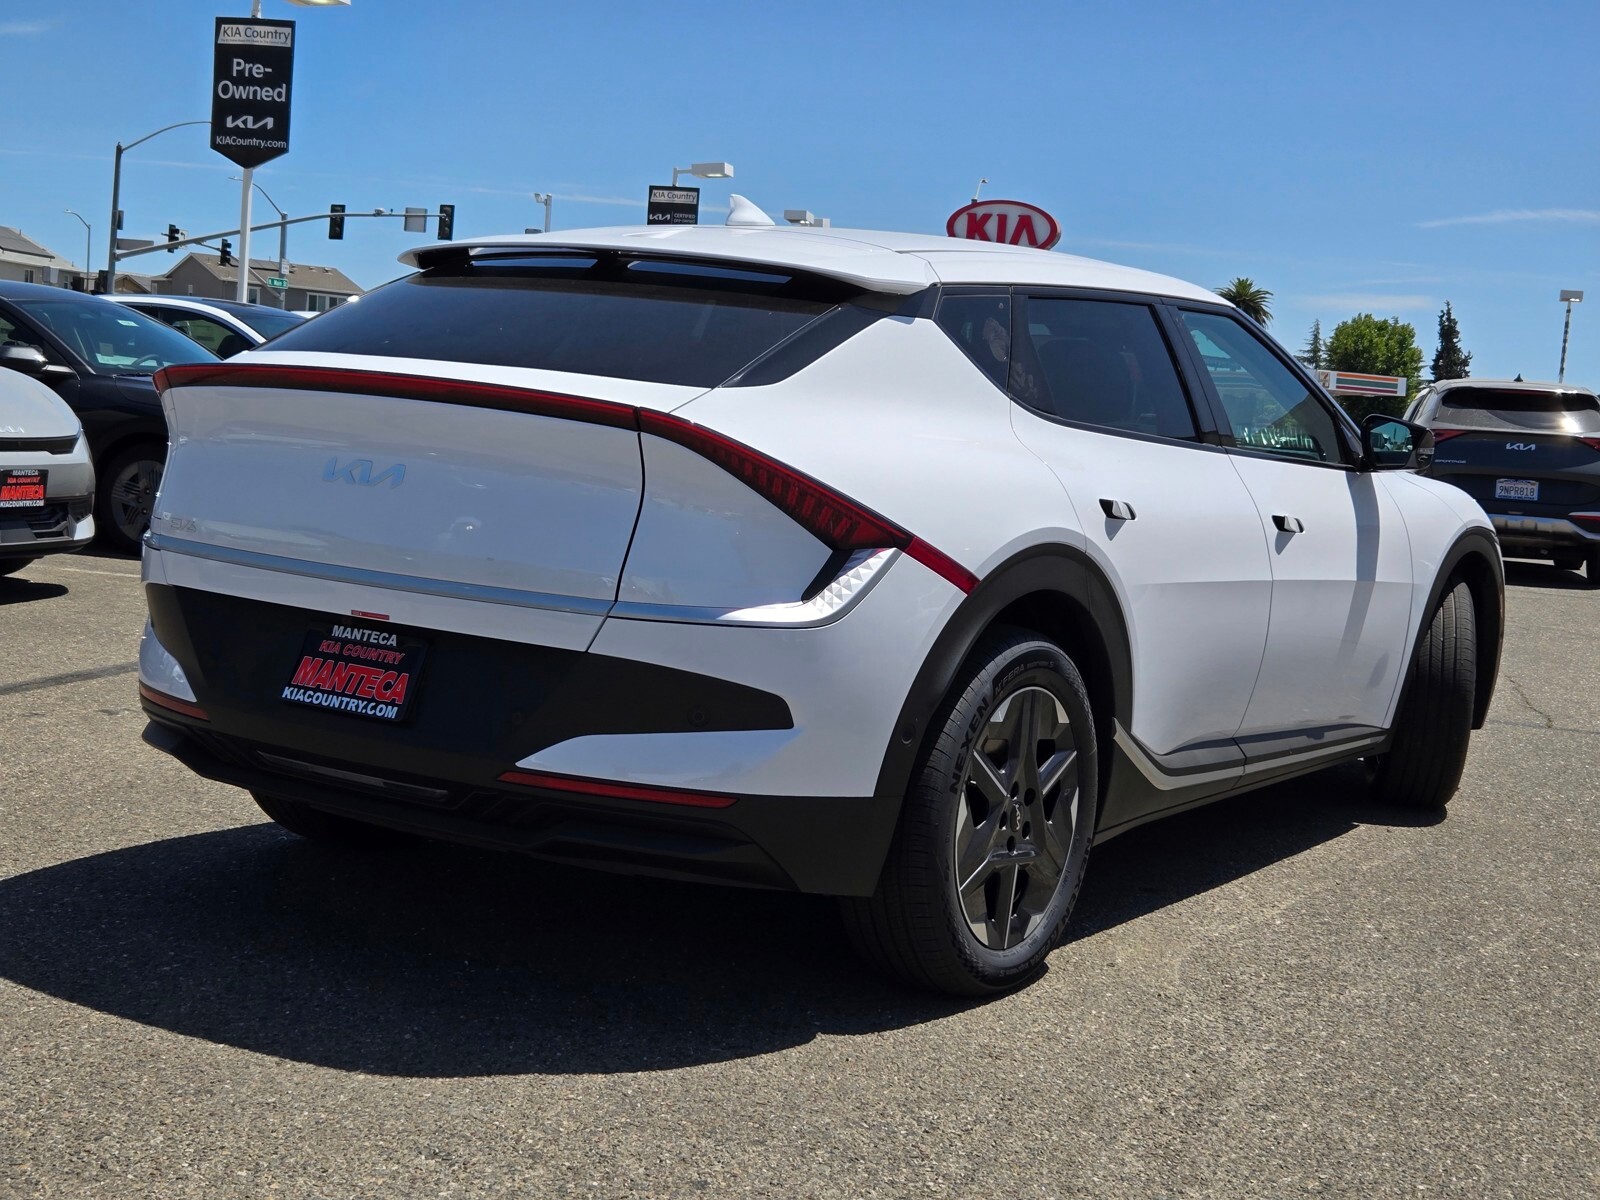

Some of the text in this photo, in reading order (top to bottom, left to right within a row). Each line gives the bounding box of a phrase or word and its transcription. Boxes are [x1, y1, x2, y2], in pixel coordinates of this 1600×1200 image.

[223, 26, 242, 38] KIA
[244, 27, 290, 43] Country
[232, 58, 273, 78] Pre-
[218, 80, 287, 102] Owned
[216, 135, 287, 149] KIACountry.com
[667, 191, 696, 201] Country
[966, 212, 1039, 246] KIA
[0, 485, 44, 500] MANTECA
[1498, 485, 1535, 497] 9NPR818
[331, 624, 398, 647] MANTECA
[318, 639, 405, 665] KIA COUNTRY
[291, 655, 410, 705] MANTECA
[282, 686, 399, 719] KIACOUNTRY.COM
[949, 696, 989, 795] NEXEN
